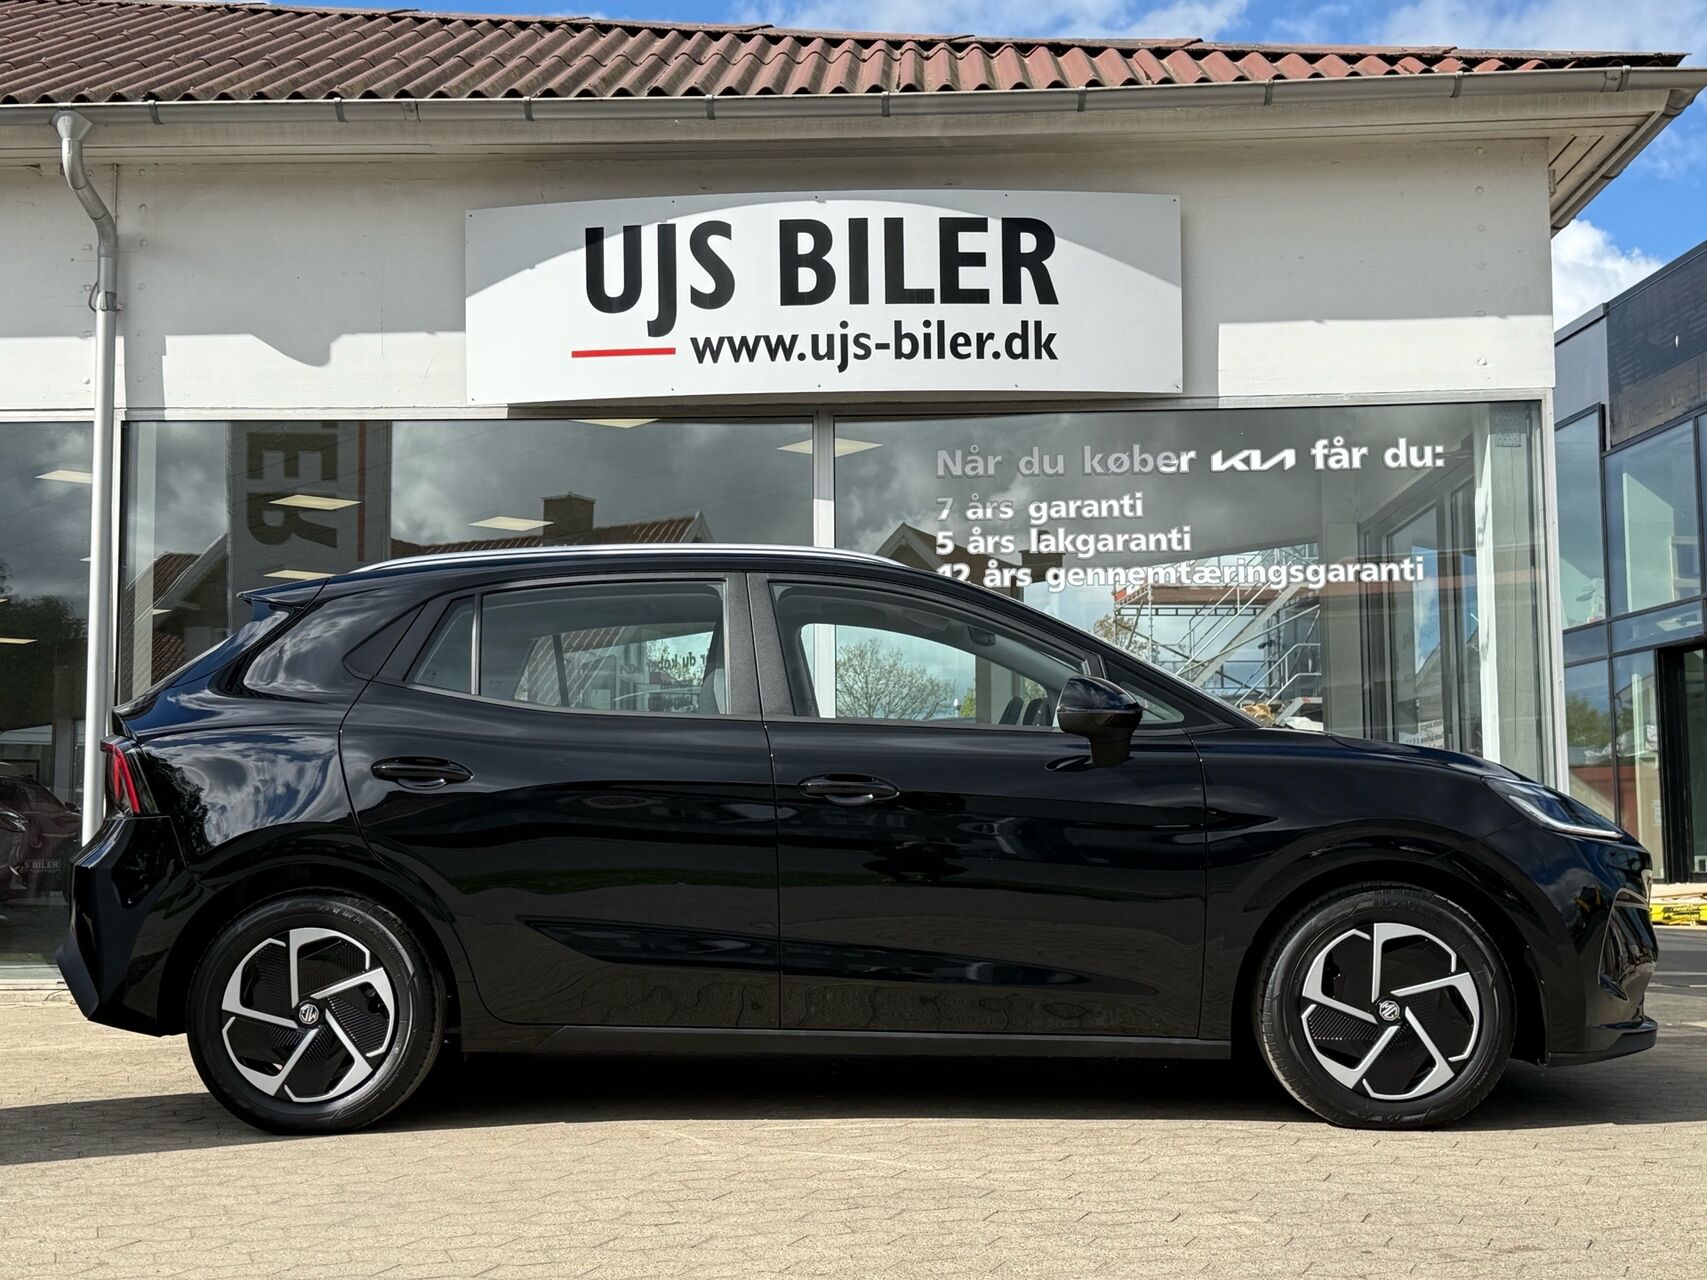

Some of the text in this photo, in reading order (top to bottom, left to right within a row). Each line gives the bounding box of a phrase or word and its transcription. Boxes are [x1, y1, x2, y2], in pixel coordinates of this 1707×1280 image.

[585, 216, 1060, 338] UJS BILER
[690, 319, 1059, 374] www.ujs-biler.dk
[936, 444, 1002, 477] Når
[1018, 446, 1064, 476] du
[1083, 444, 1197, 475] køber
[1310, 436, 1369, 470] får
[1384, 437, 1446, 469] du:
[936, 492, 1144, 525] 7 års garanti
[935, 525, 1192, 557] 5 års lakgaranti
[983, 559, 1032, 588] års
[1045, 556, 1424, 592] gennemtæringsgaranti
